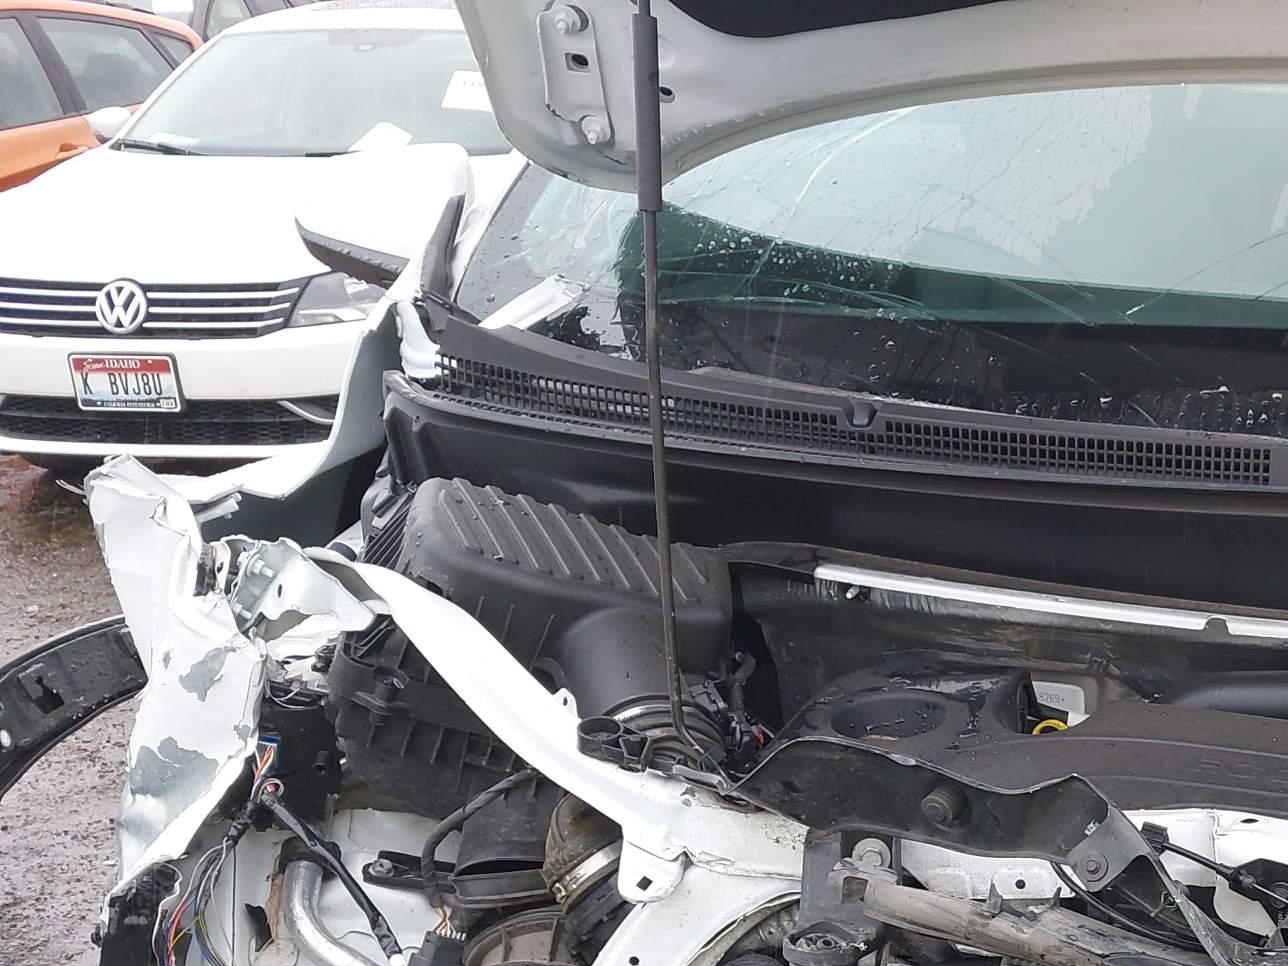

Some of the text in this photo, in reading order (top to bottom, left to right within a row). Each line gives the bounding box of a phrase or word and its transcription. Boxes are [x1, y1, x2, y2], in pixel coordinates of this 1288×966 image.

[104, 359, 141, 369] IDAHO
[80, 372, 164, 396] K BVJ8U
